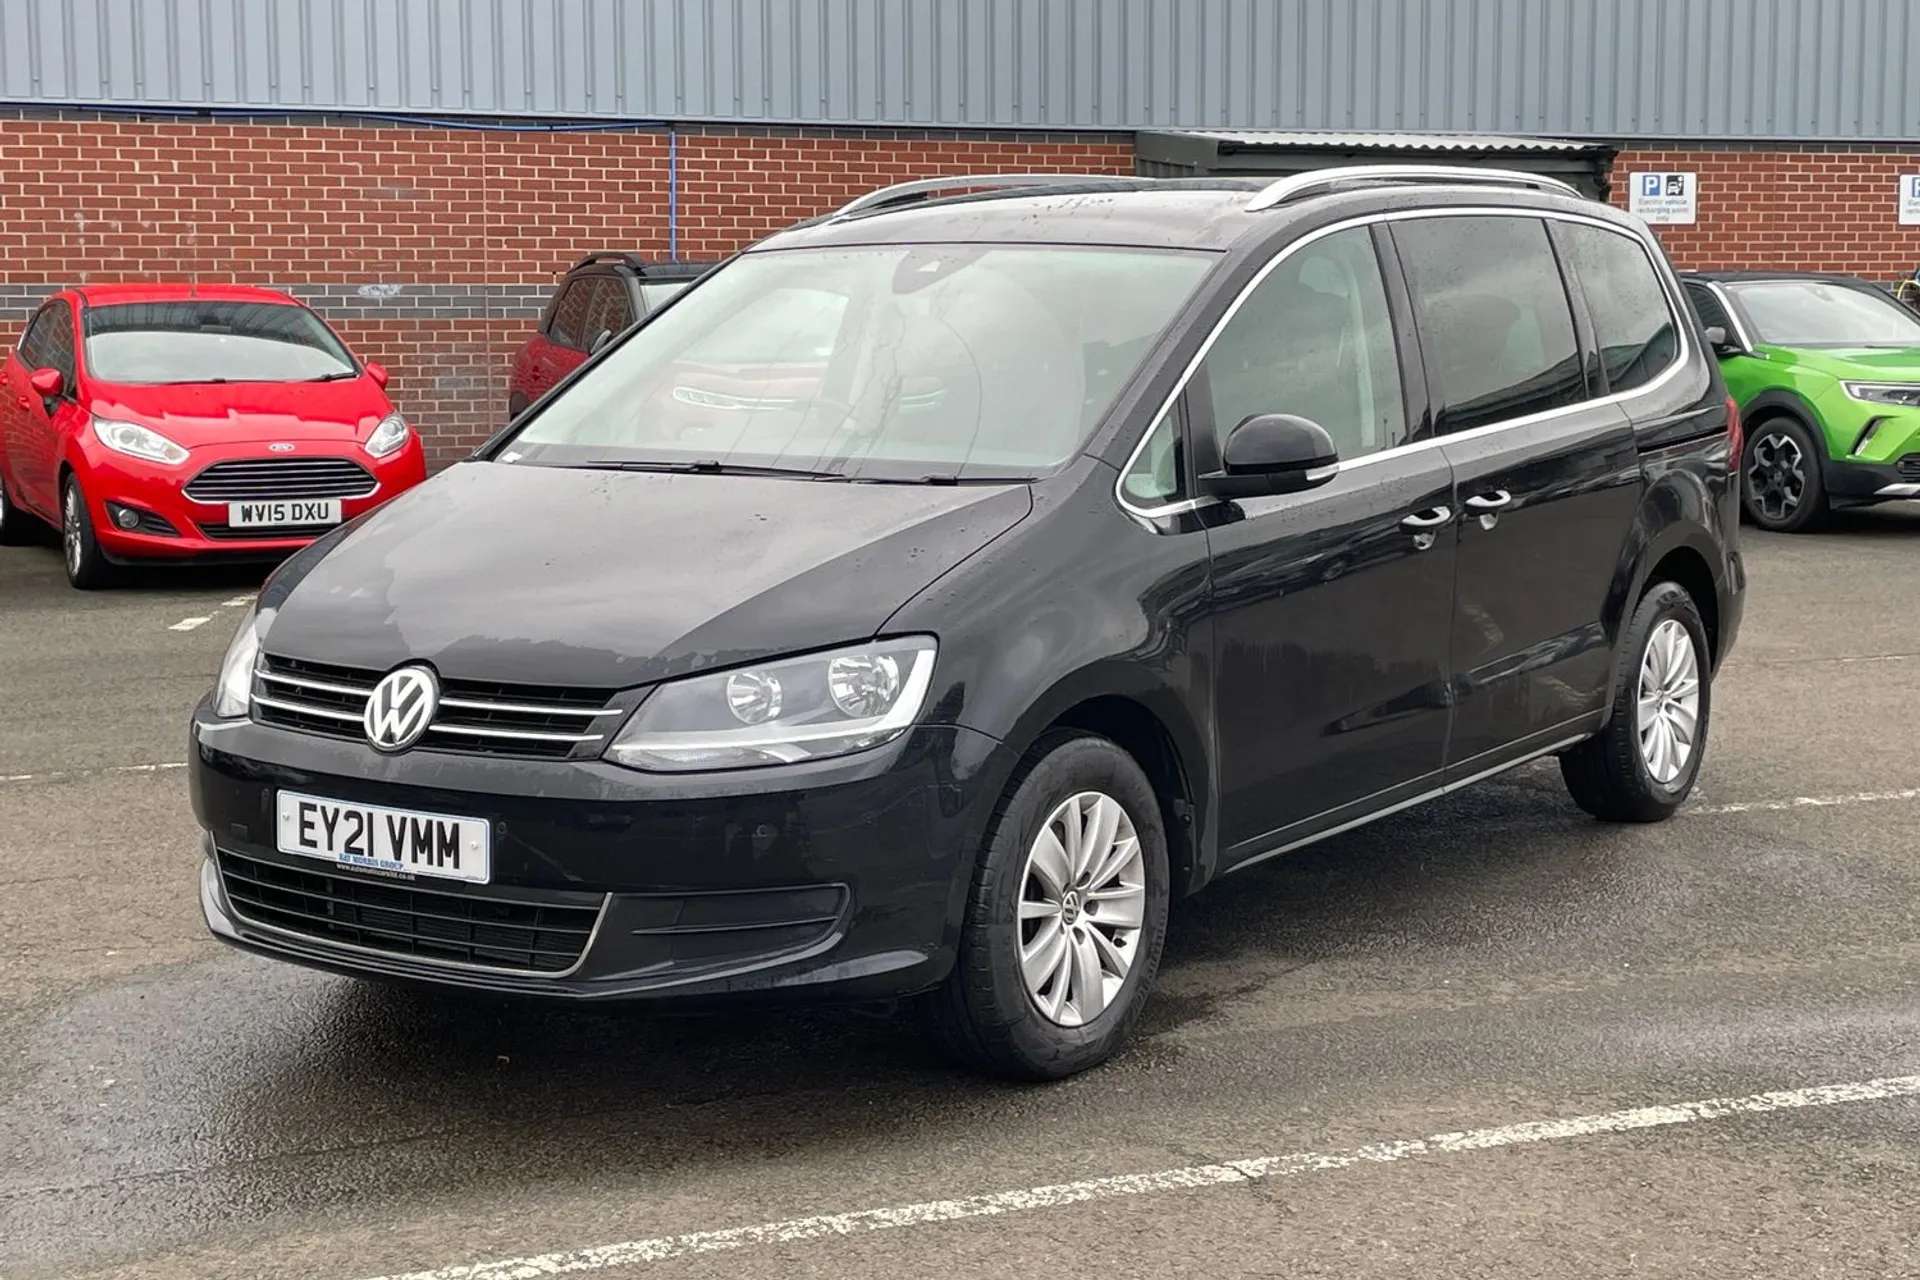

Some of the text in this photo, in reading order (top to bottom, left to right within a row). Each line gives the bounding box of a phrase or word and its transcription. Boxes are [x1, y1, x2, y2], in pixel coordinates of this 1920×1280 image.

[1645, 176, 1659, 195] P
[241, 502, 329, 523] WV15 DXU
[299, 801, 460, 870] EY21 VMM
